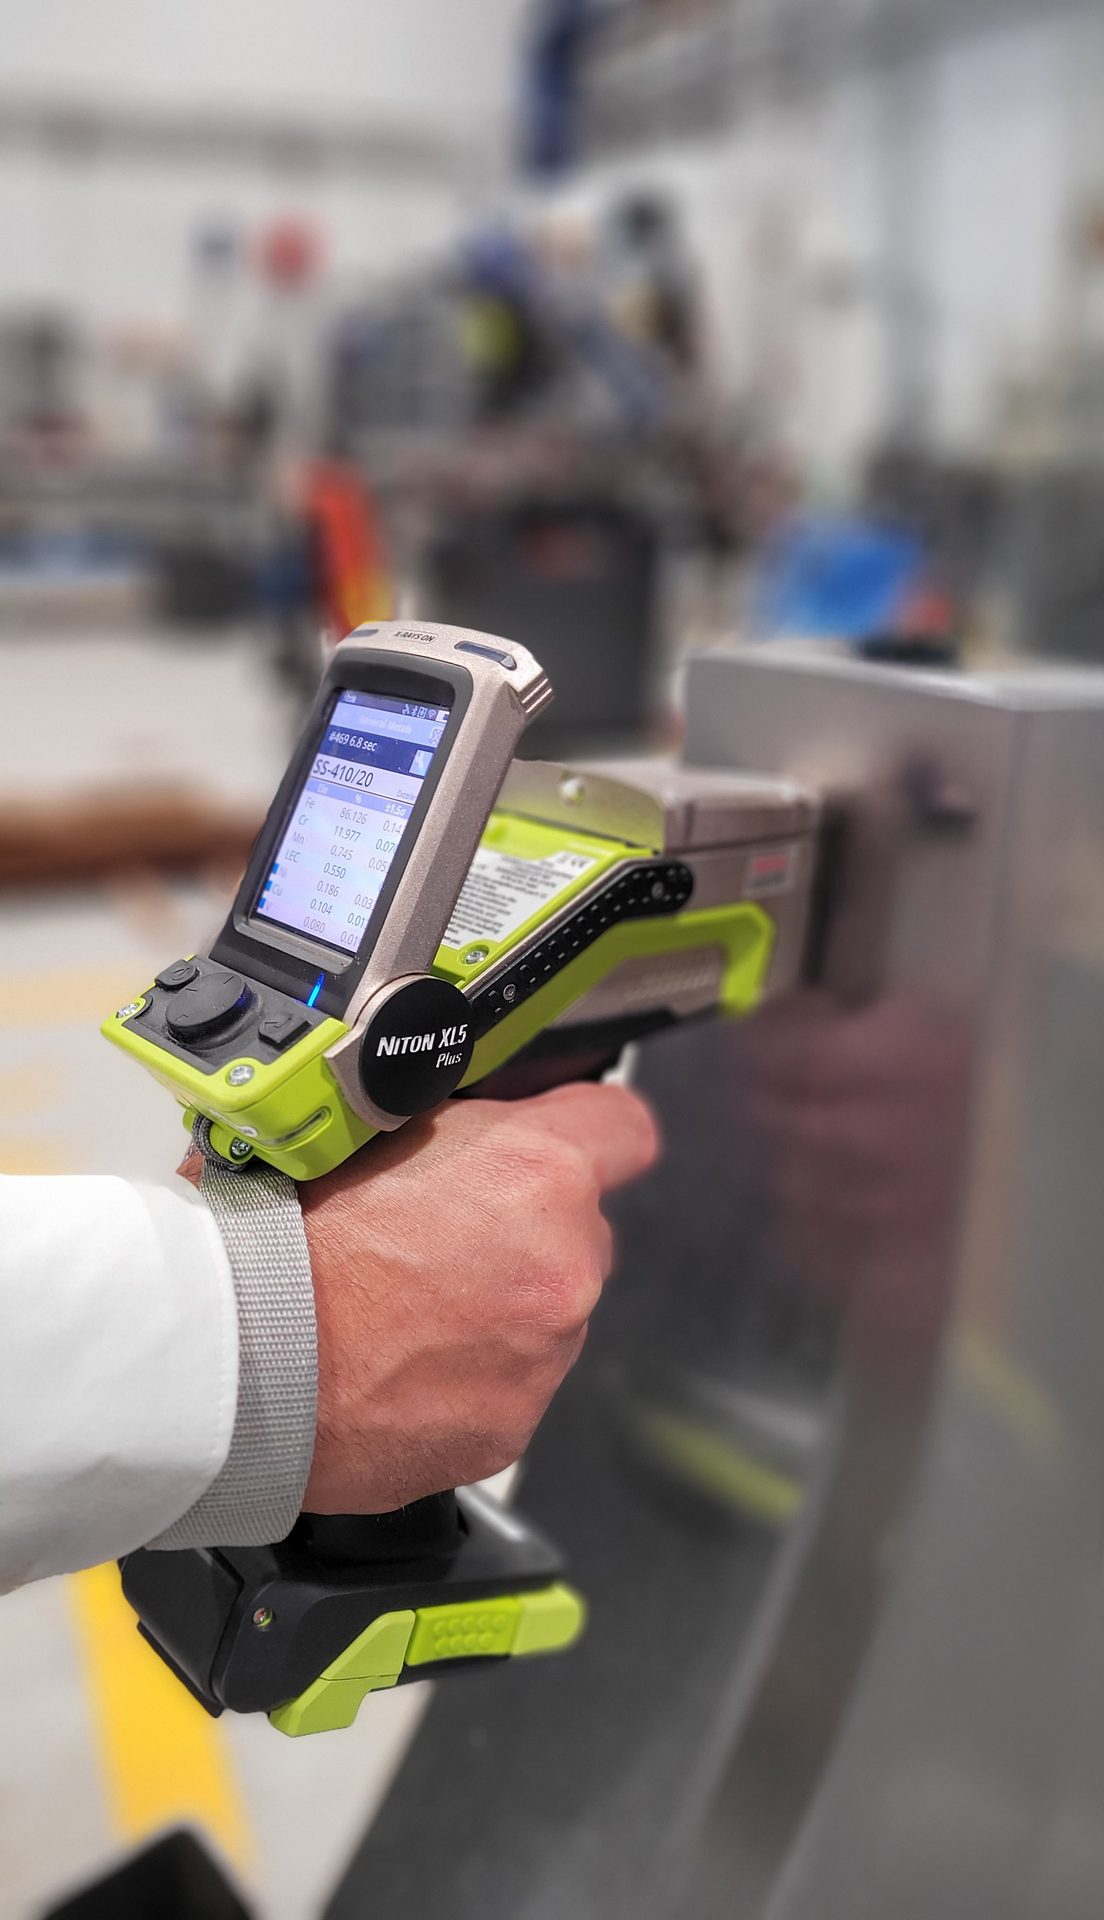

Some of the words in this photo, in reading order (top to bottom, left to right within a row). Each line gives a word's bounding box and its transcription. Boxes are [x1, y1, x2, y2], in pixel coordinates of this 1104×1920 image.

[349, 735, 363, 748] 6.8
[362, 740, 378, 752] sec
[313, 759, 374, 787] SS-410/20
[339, 807, 368, 825] 86.126
[334, 825, 361, 842] 11.977
[330, 845, 354, 861] 0.745
[285, 849, 301, 863] LEC
[323, 862, 347, 879] 0.550
[317, 880, 340, 897] 0.186
[310, 898, 333, 916] 0.104
[303, 916, 326, 934] 0.080
[376, 1033, 436, 1057] NITON
[438, 1024, 468, 1049] XL5
[436, 1052, 462, 1068] Plus
